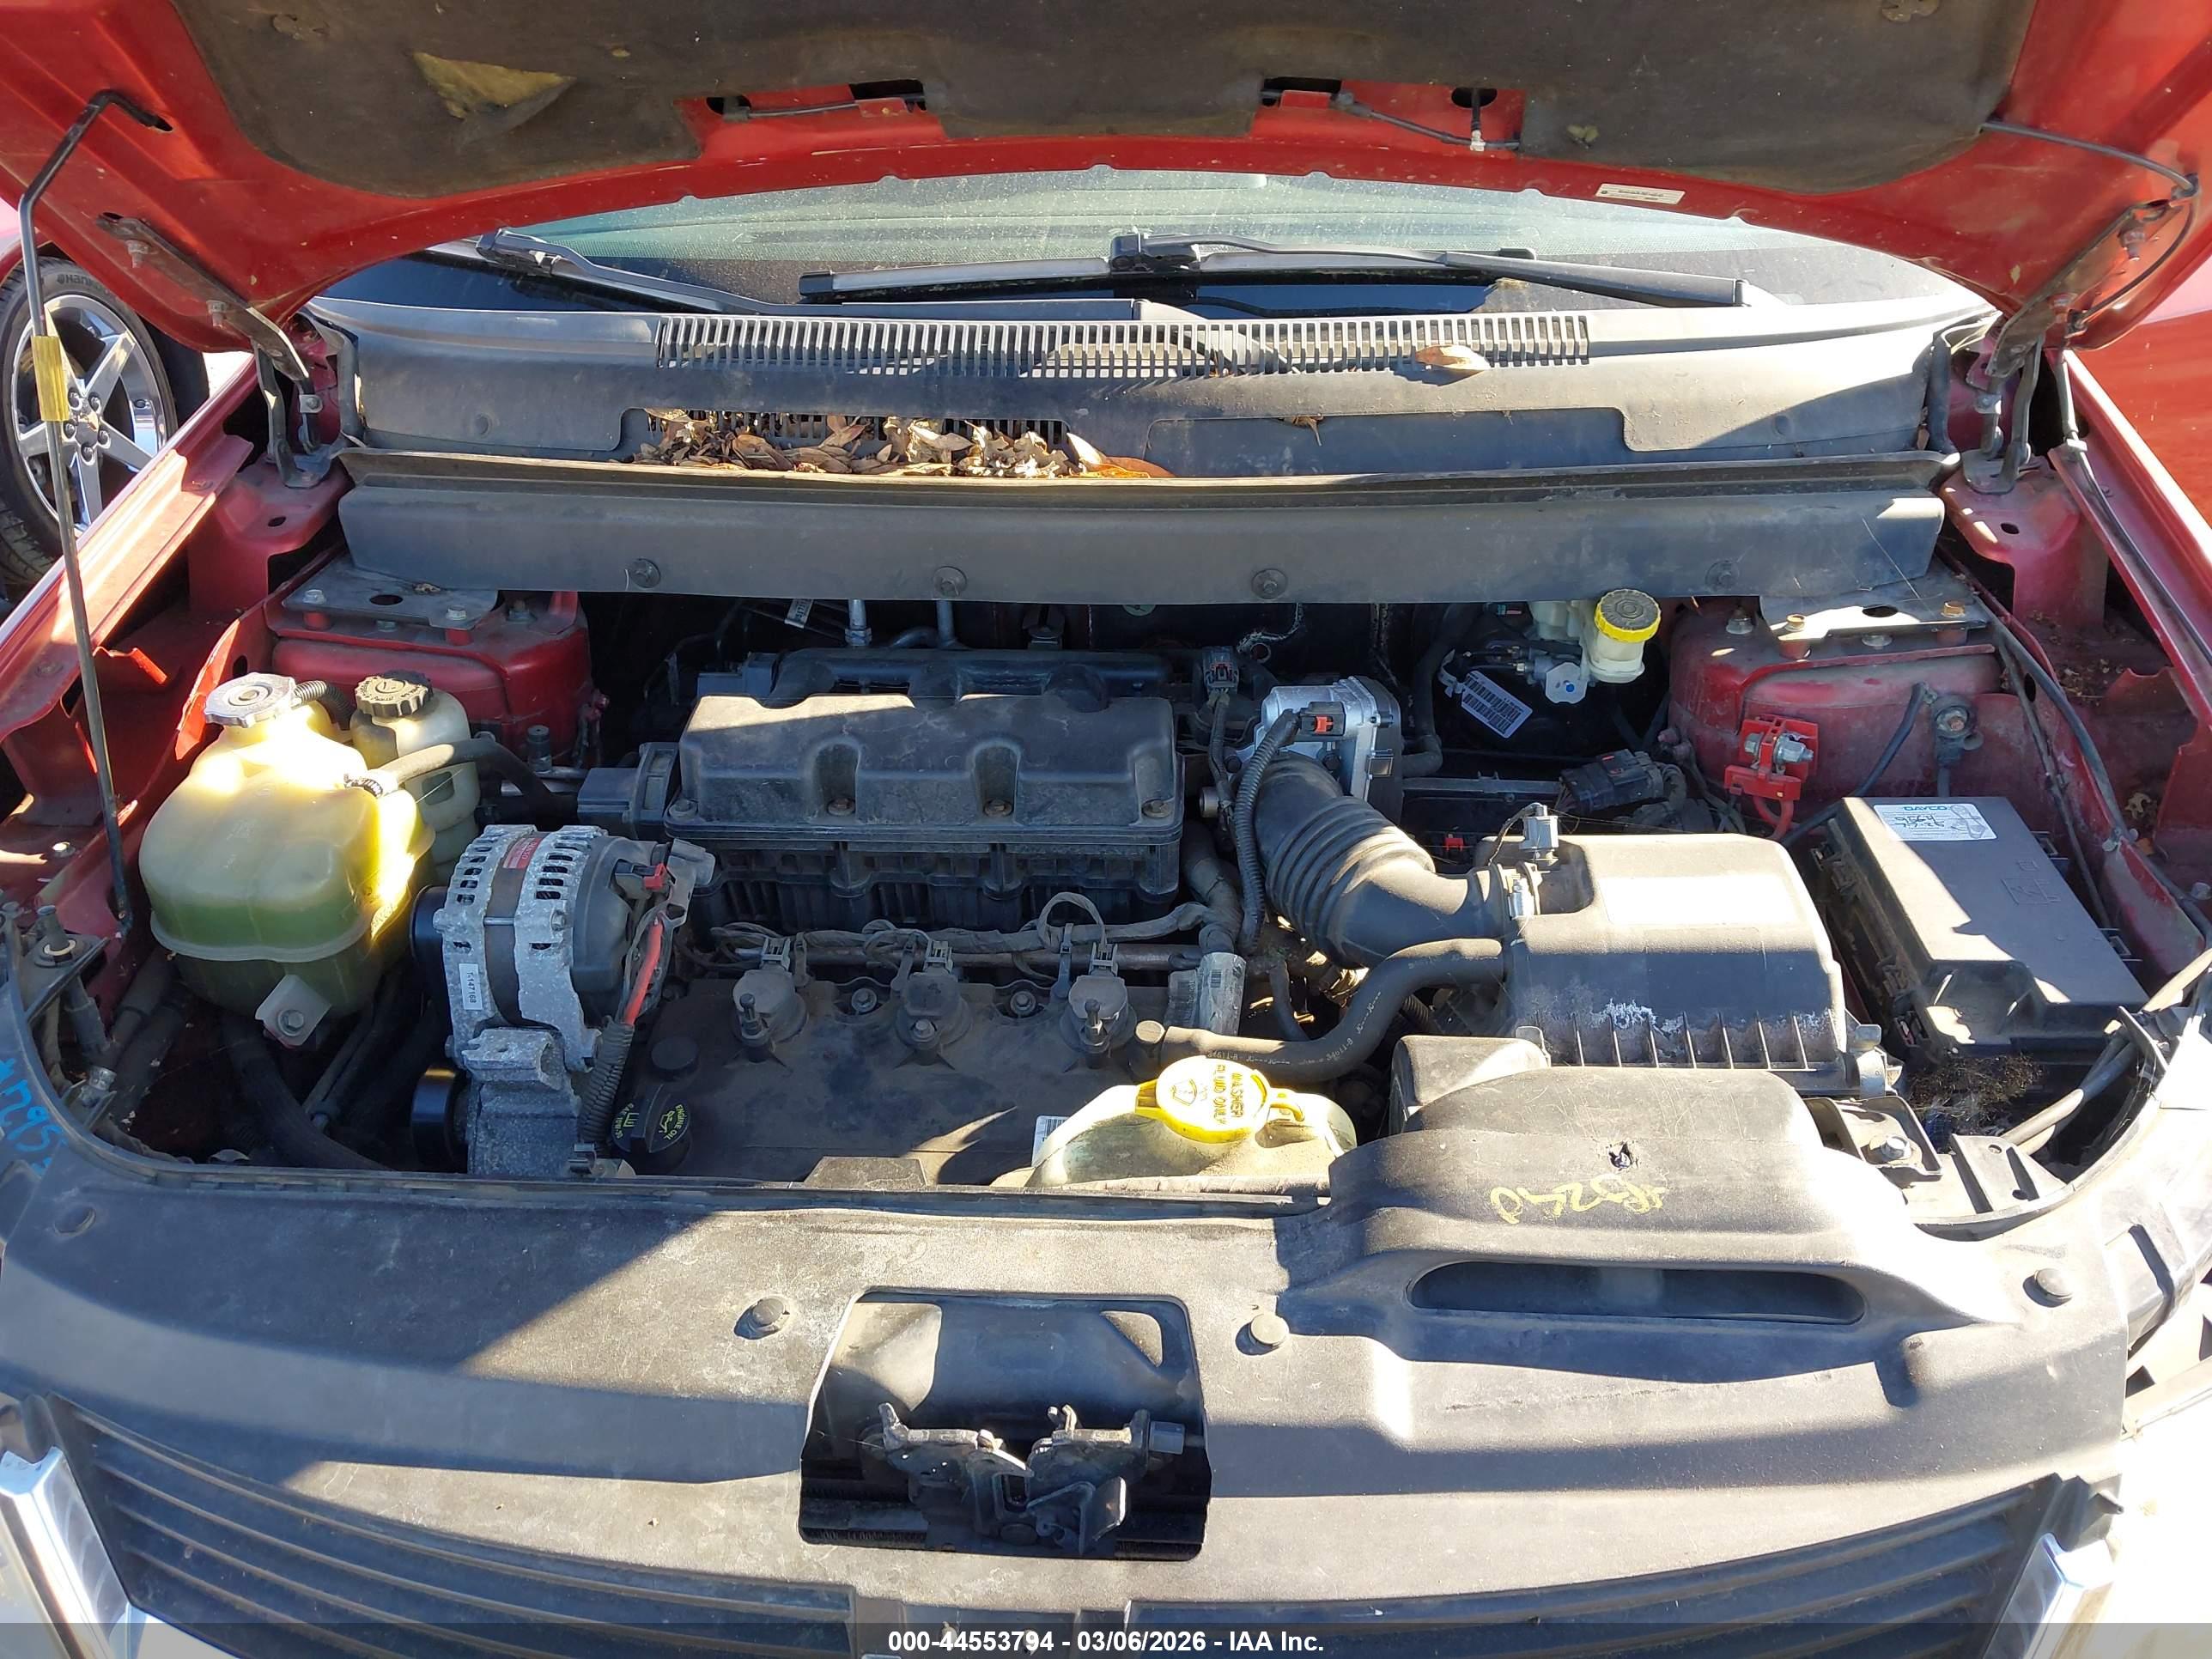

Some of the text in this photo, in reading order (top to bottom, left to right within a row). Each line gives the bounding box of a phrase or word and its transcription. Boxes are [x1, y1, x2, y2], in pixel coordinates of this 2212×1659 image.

[1212, 1096, 1228, 1125] ONLY
[1230, 1073, 1244, 1118] WASHER
[663, 1104, 687, 1140] ENGINE OIL
